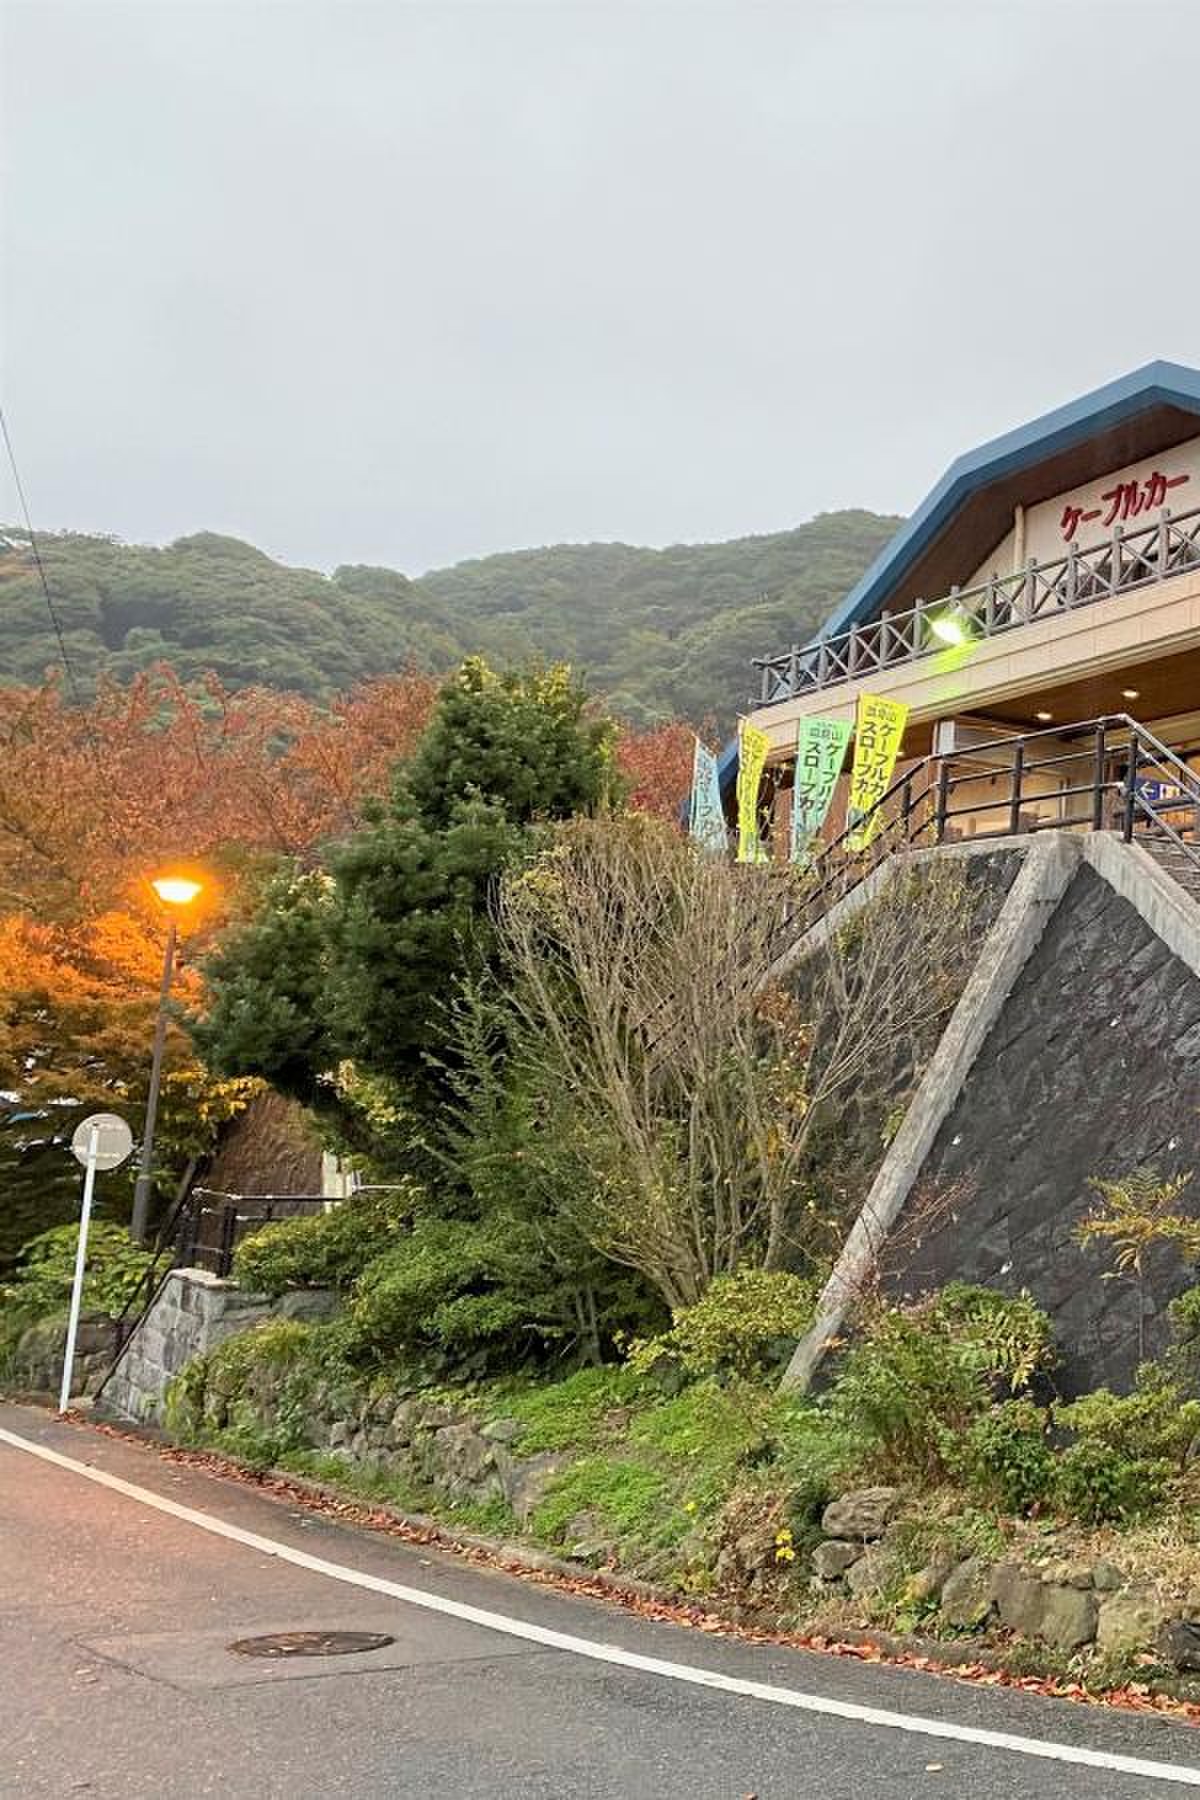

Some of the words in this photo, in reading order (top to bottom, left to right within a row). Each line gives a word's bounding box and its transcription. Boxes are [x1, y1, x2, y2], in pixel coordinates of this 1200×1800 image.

[1060, 471, 1190, 542] ケーブルカー
